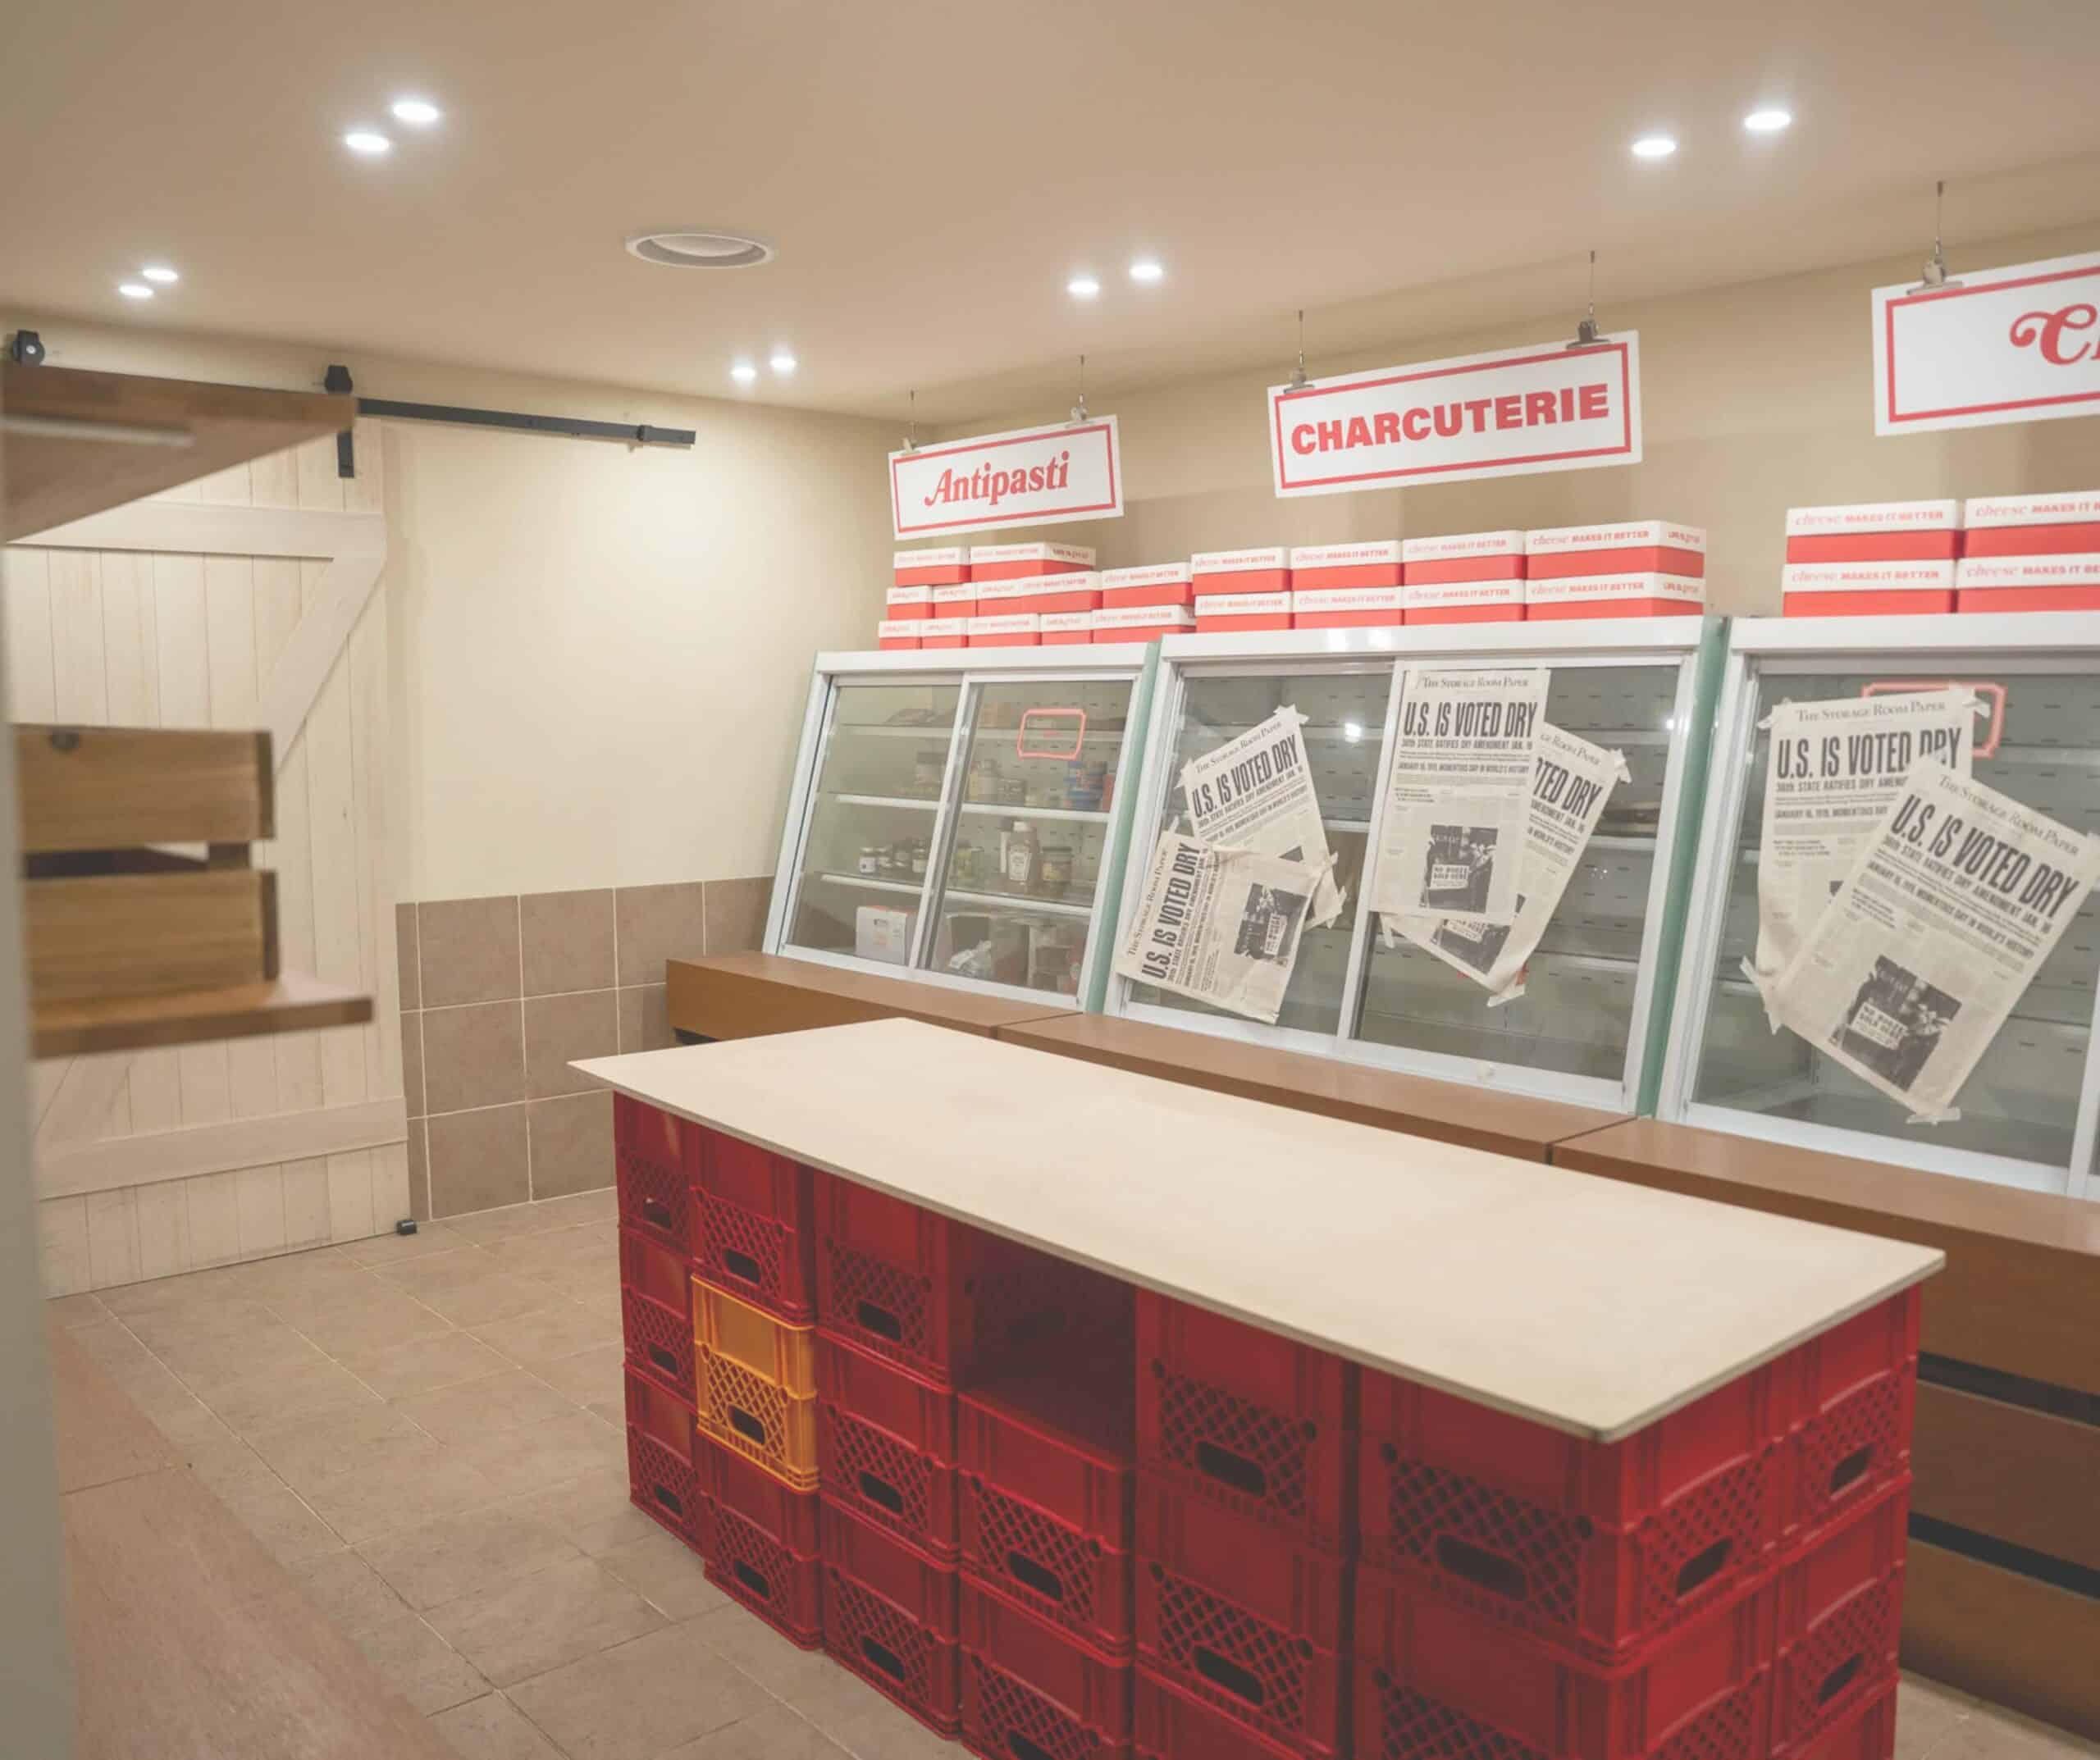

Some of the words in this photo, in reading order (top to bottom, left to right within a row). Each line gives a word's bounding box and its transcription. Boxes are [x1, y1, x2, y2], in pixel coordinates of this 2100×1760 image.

[2009, 303, 2100, 366] C
[1291, 383, 1609, 456] CHARCUTERIE
[924, 450, 1071, 506] Antipasti
[1404, 702, 1430, 736] U.S.
[1434, 702, 1451, 737] IS
[1454, 702, 1502, 737] VOTED
[1504, 702, 1537, 737] DRY
[1192, 783, 1217, 818] U.S.
[1216, 773, 1232, 805] IS
[1230, 750, 1272, 796] VOTED
[1271, 733, 1299, 774] DRY
[1777, 738, 1814, 779] U.S.
[1820, 736, 1842, 777] IS
[1847, 731, 1912, 776] VOTED
[1533, 756, 1569, 805] TED
[1561, 774, 1604, 820] DRY
[1172, 842, 1201, 876] DRY
[1890, 793, 1936, 847] U.S.
[1928, 814, 1964, 858] IS
[1952, 826, 2032, 895] VOTED
[2018, 863, 2080, 919] DRY
[1157, 876, 1192, 927] VOTED
[1141, 950, 1172, 979] U.S.
[1151, 928, 1177, 948] IS
